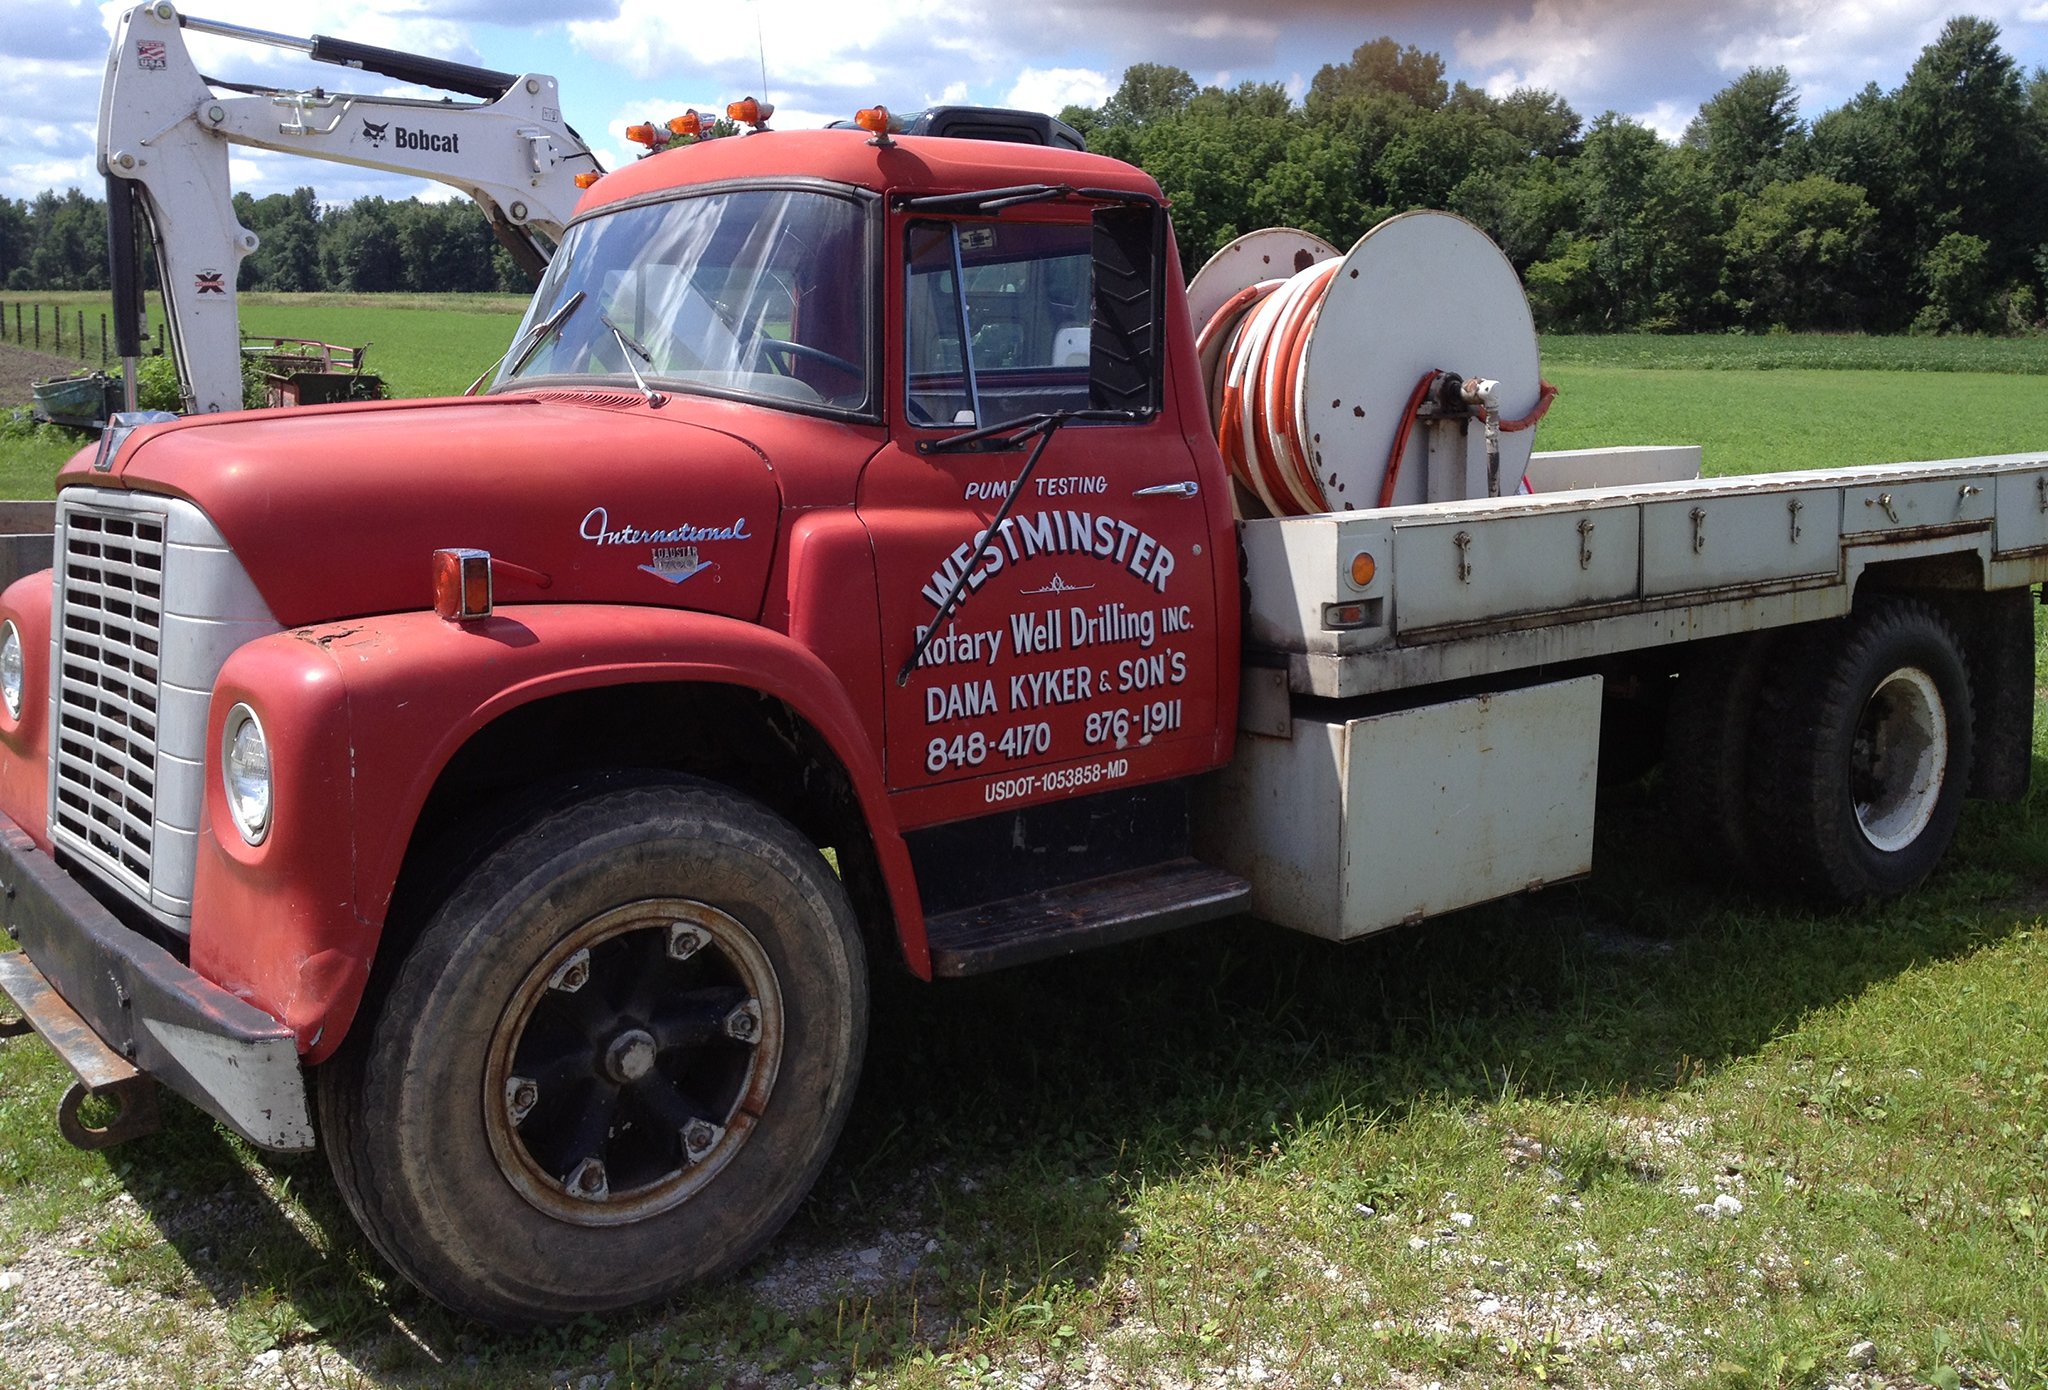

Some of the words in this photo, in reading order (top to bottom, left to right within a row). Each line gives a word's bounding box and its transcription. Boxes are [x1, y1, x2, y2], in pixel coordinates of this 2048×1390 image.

[395, 127, 459, 154] Bobcat
[1036, 476, 1108, 496] TESTING
[580, 507, 751, 546] International
[652, 546, 698, 559] LOADSTAR
[921, 510, 1175, 613] WESTMINSTER
[916, 623, 1002, 666] Rotary
[1010, 609, 1061, 654] Well
[1070, 603, 1155, 647] Drilling
[1162, 605, 1194, 633] INC.
[927, 679, 998, 722] DANA
[1010, 666, 1091, 709] KYKER
[1099, 670, 1112, 692] &
[1119, 648, 1186, 691] SON'S
[927, 722, 1051, 771] 848-4170
[1085, 699, 1182, 743] 876-1911
[985, 759, 1128, 803] USDOT-1053858-MD
